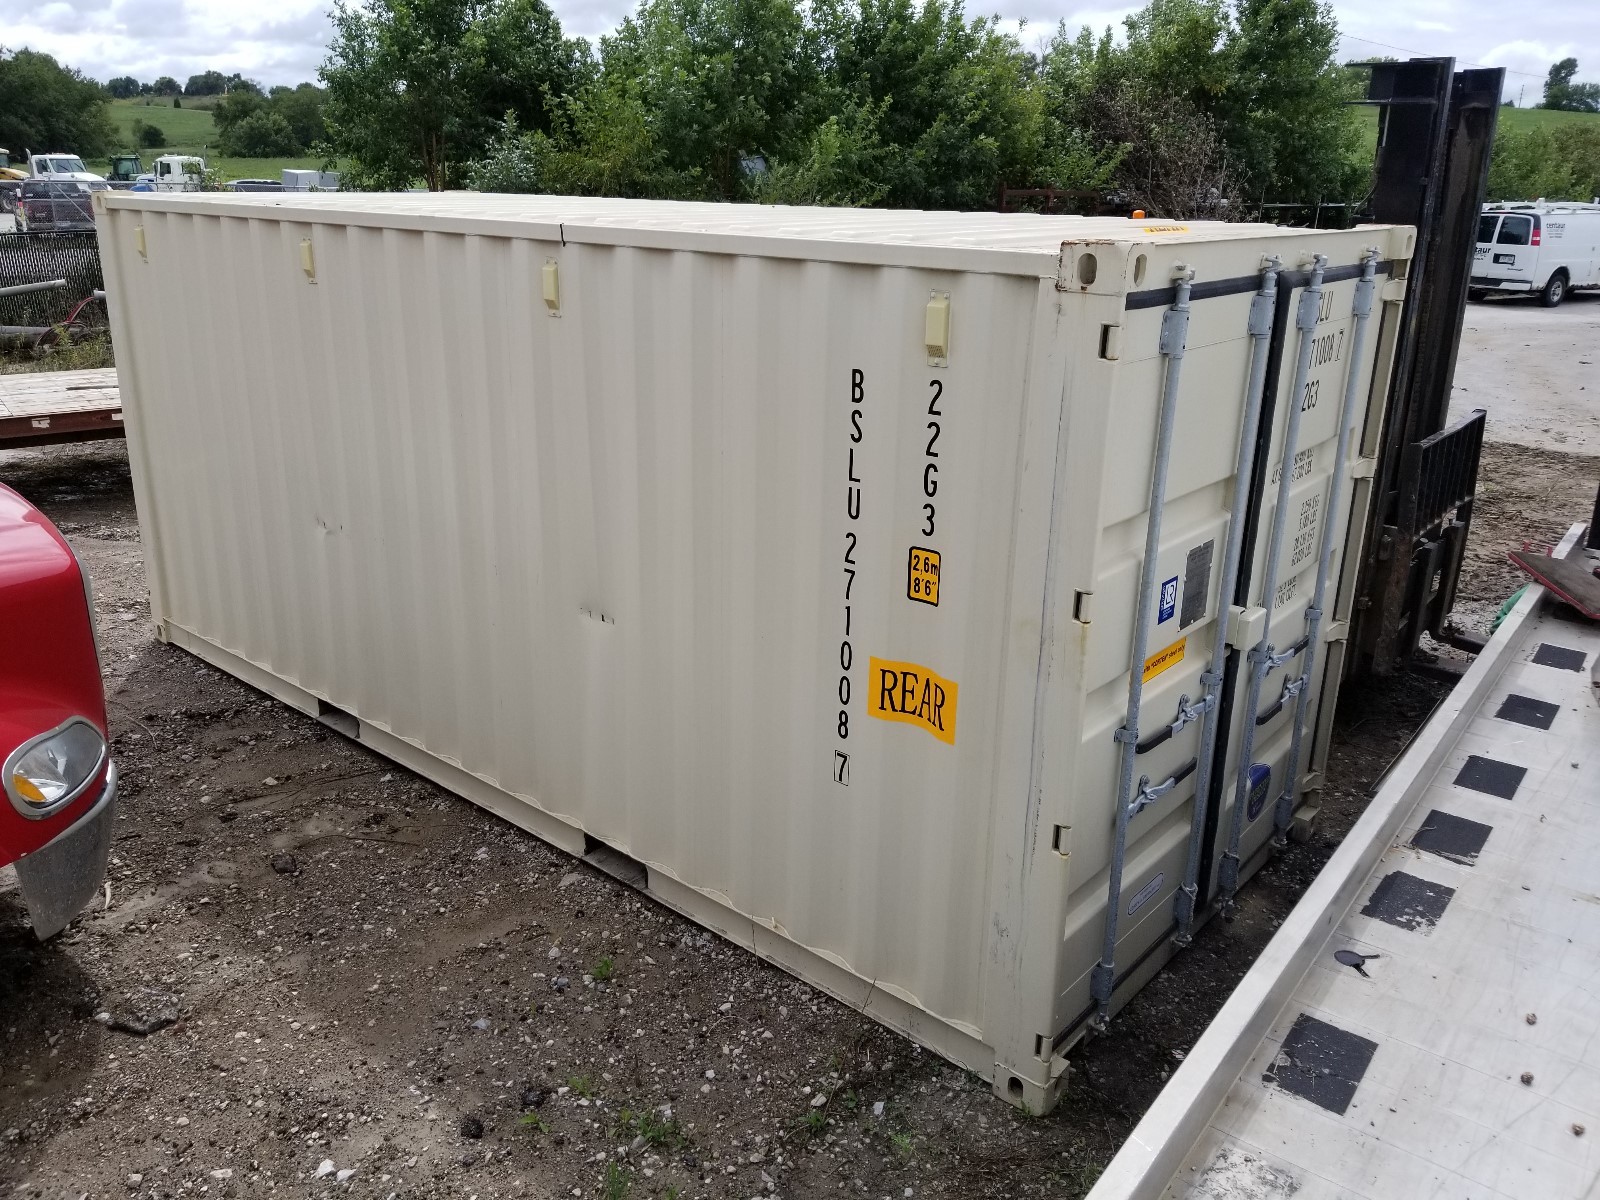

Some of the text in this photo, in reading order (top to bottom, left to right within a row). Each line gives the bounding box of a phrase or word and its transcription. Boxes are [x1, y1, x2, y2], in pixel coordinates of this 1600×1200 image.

[1474, 246, 1492, 254] taur
[1317, 290, 1334, 325] LU
[1308, 332, 1335, 370] 71008
[1301, 379, 1320, 413] 2G3
[847, 368, 865, 521] BSLU
[921, 379, 943, 537] 22G3
[837, 532, 857, 740] 271008
[878, 667, 946, 733] REAR
